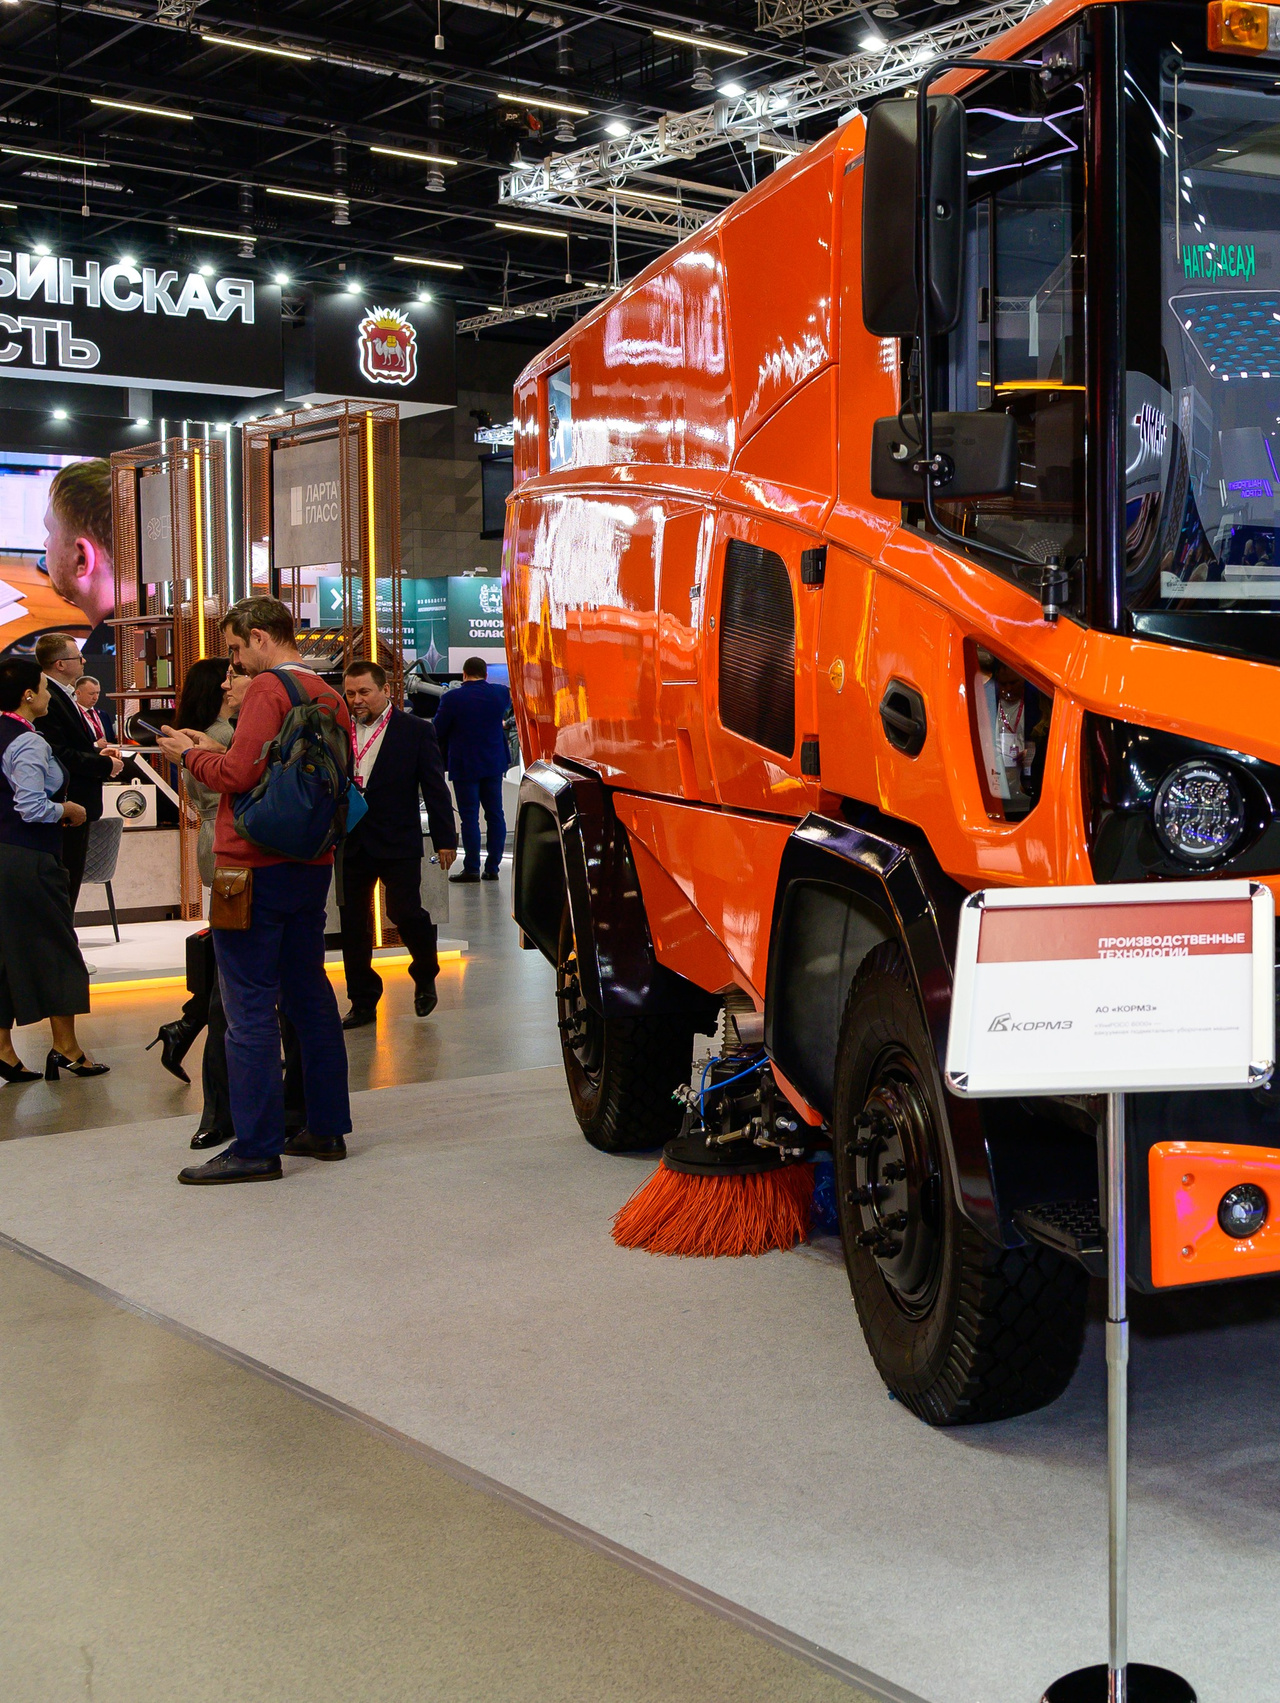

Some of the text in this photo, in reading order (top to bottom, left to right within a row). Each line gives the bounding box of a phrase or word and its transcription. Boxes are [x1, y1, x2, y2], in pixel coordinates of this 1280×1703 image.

[305, 480, 338, 503] ЛАРТА
[305, 502, 338, 525] ГЛАСС
[1098, 932, 1246, 949] ПРОИЗВОДСТВЕННЫЕ
[1098, 947, 1189, 959] ТЕХНОЛОГИИ
[1111, 1004, 1157, 1013] «КОРМЗ»
[1010, 1020, 1073, 1032] КОРМЗ
